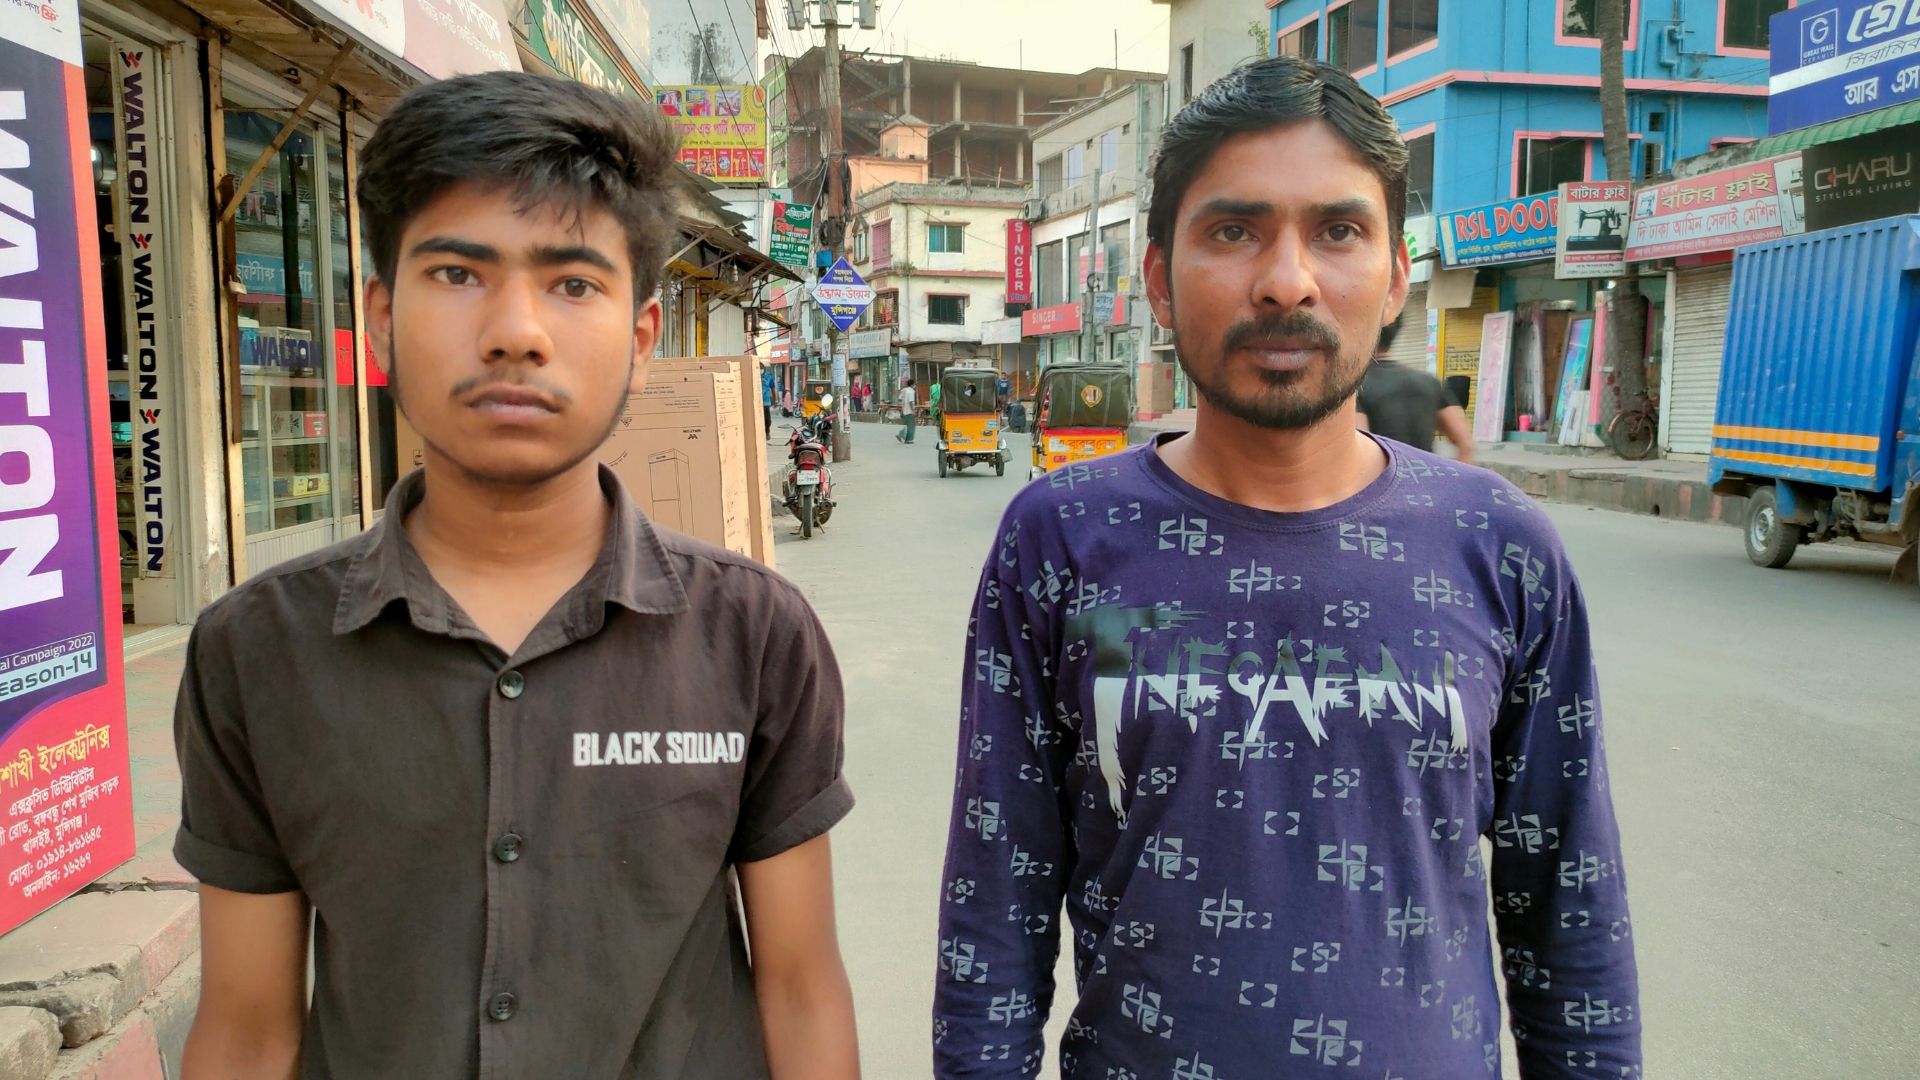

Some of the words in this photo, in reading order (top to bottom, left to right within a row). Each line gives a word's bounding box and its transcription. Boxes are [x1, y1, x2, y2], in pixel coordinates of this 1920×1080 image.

[1844, 77, 1879, 105] আর
[1891, 65, 1920, 94] এস
[123, 72, 150, 223] WALTON
[1814, 152, 1911, 191] CHARU
[1570, 185, 1600, 199] বাটার
[1603, 184, 1628, 200] ফ্লাই
[1660, 185, 1718, 210] বাটার
[1724, 172, 1776, 200] ফ্লাই
[1815, 188, 1862, 203] STYLISH
[1869, 179, 1912, 194] LIVING
[1454, 210, 1491, 243] RSL
[1672, 212, 1703, 236] আমিন
[1706, 207, 1740, 233] সেলাই
[1743, 200, 1778, 226] মেশিন
[1014, 222, 1024, 291] SINGER
[130, 253, 158, 400] WALTON
[1032, 309, 1056, 324] SINGER
[142, 428, 163, 572] WALTON
[12, 645, 66, 667] Campaign
[68, 635, 92, 651] 2022
[0, 651, 92, 697] eason-14
[573, 732, 663, 766] BLACK
[666, 731, 746, 764] SQUAD
[0, 749, 34, 789] শাখী
[64, 852, 92, 878] ১৬২৬৭
